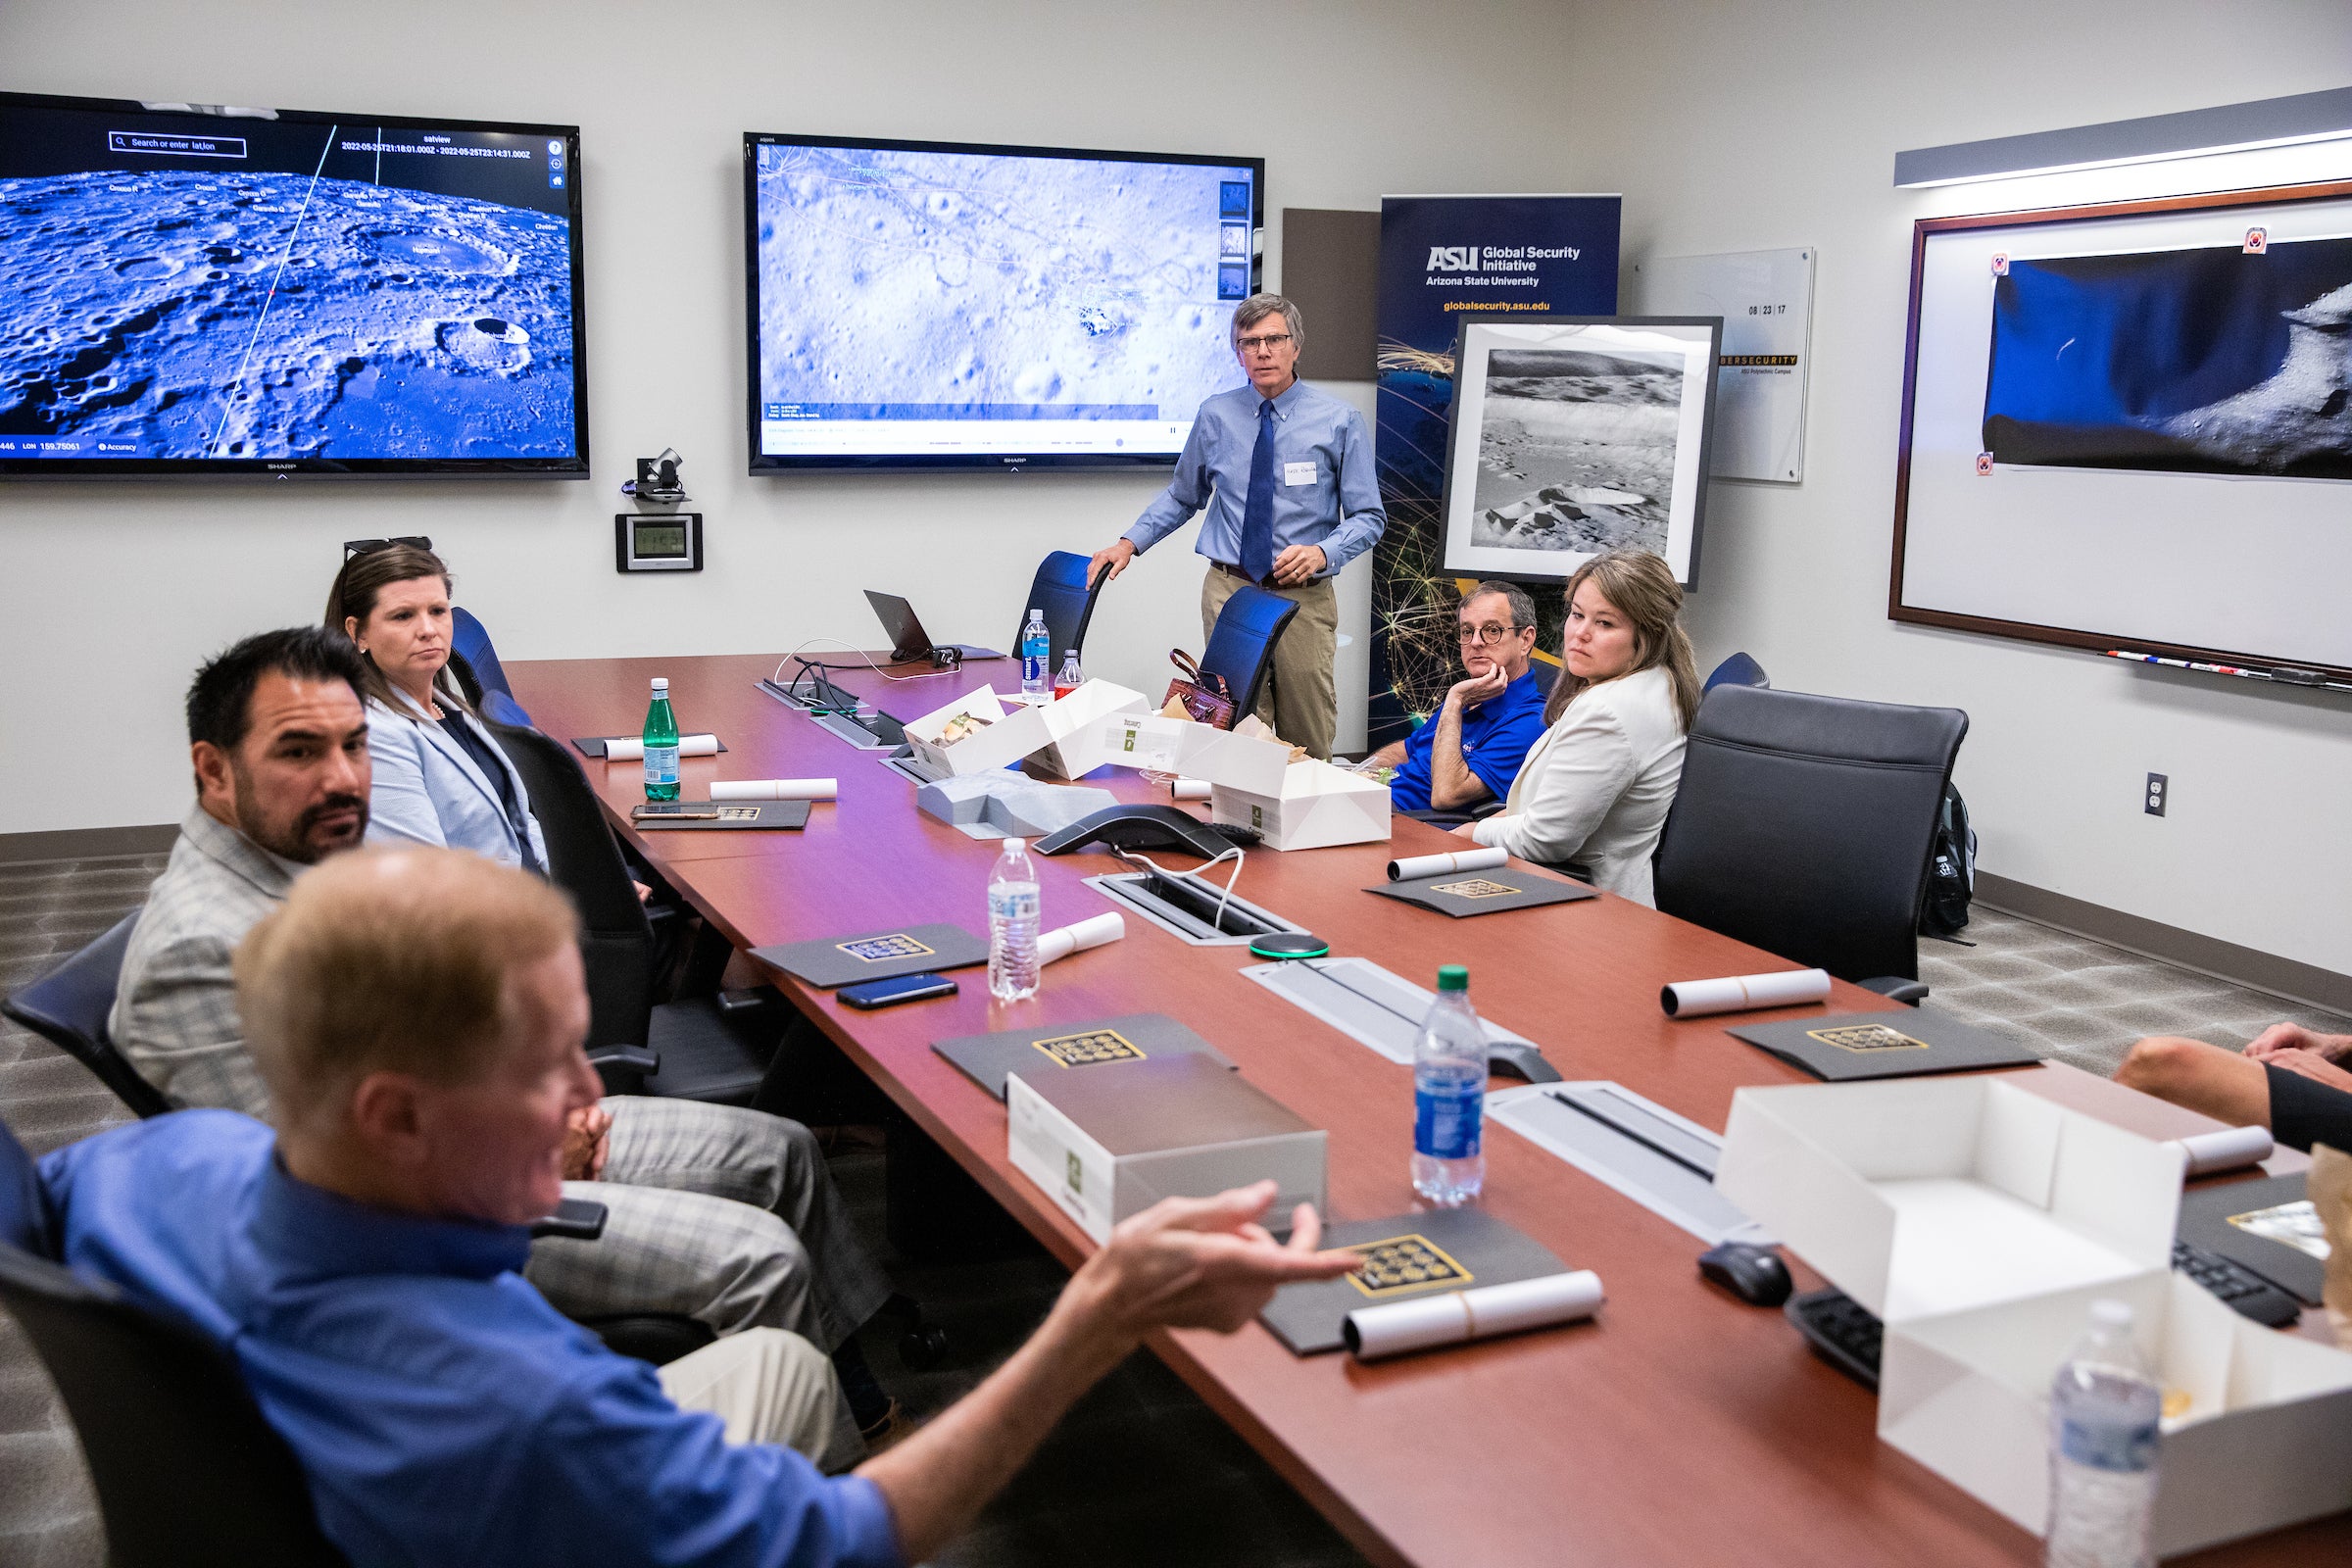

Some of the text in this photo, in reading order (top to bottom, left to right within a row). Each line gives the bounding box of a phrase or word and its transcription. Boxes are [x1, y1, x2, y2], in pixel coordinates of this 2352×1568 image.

[131, 138, 158, 147] Search
[169, 140, 189, 149] enter
[423, 134, 451, 143] satview
[1426, 246, 1479, 271] ASU
[1483, 246, 1580, 261] Global Security
[1483, 260, 1537, 271] Initiative
[1426, 276, 1540, 287] Arizona State University
[1444, 301, 1550, 312] globalsecurity.asu.edu
[1749, 305, 1786, 315] 08 23 17
